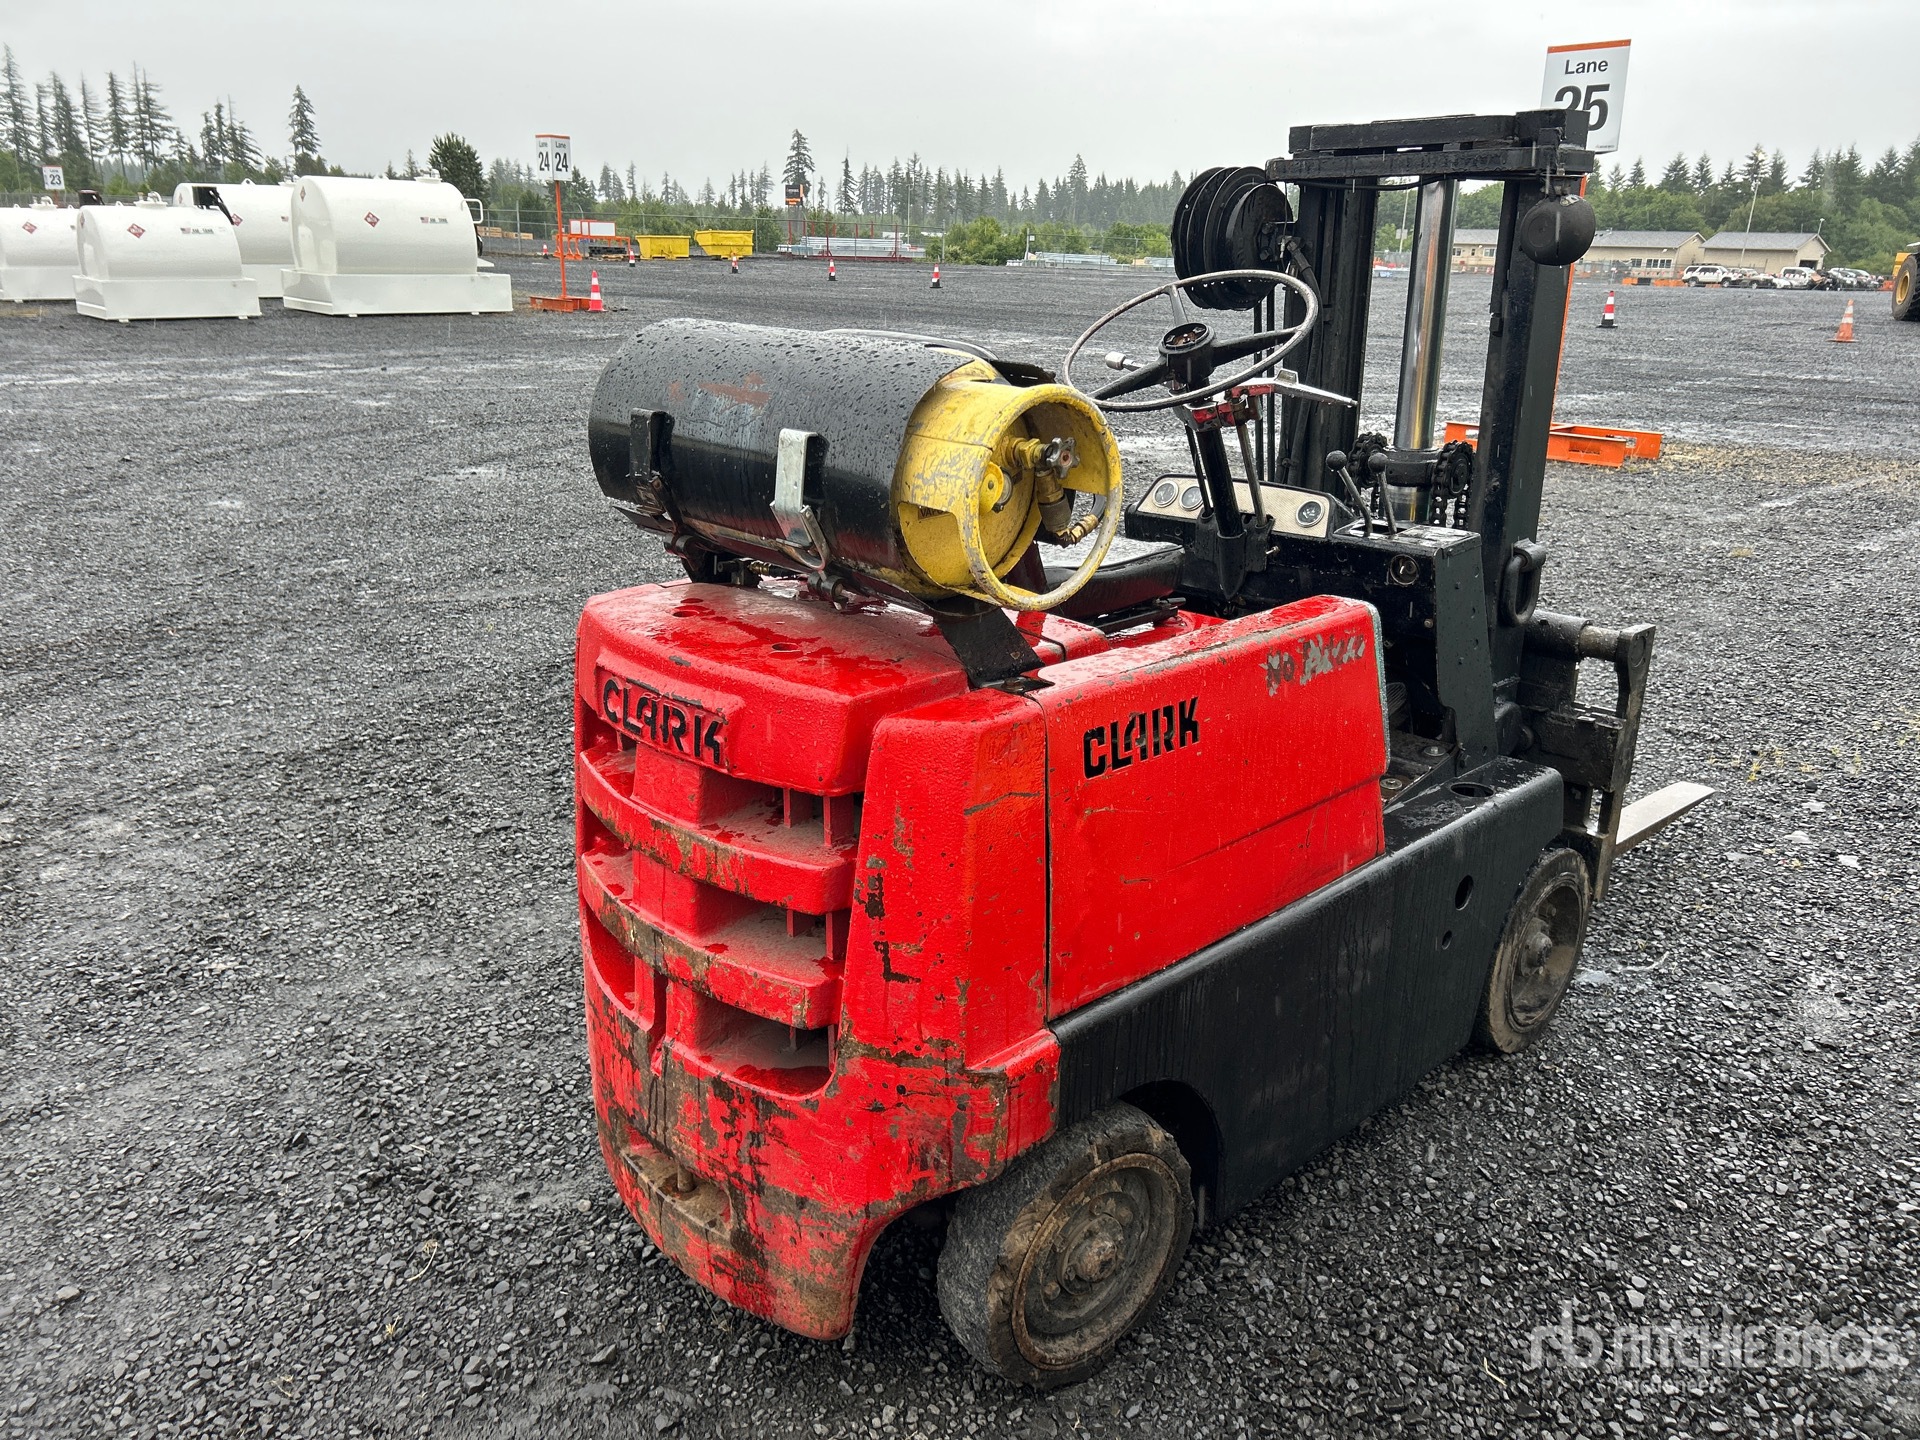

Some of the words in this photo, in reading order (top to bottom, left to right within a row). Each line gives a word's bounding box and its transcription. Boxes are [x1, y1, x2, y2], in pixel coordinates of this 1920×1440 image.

[1565, 60, 1608, 74] Lane
[1554, 84, 1610, 131] 25
[555, 141, 567, 149] Lane
[538, 151, 550, 171] 24
[554, 152, 568, 172] 24
[49, 174, 61, 185] 23
[603, 678, 722, 765] CLARK
[1083, 696, 1200, 780] CLARK
